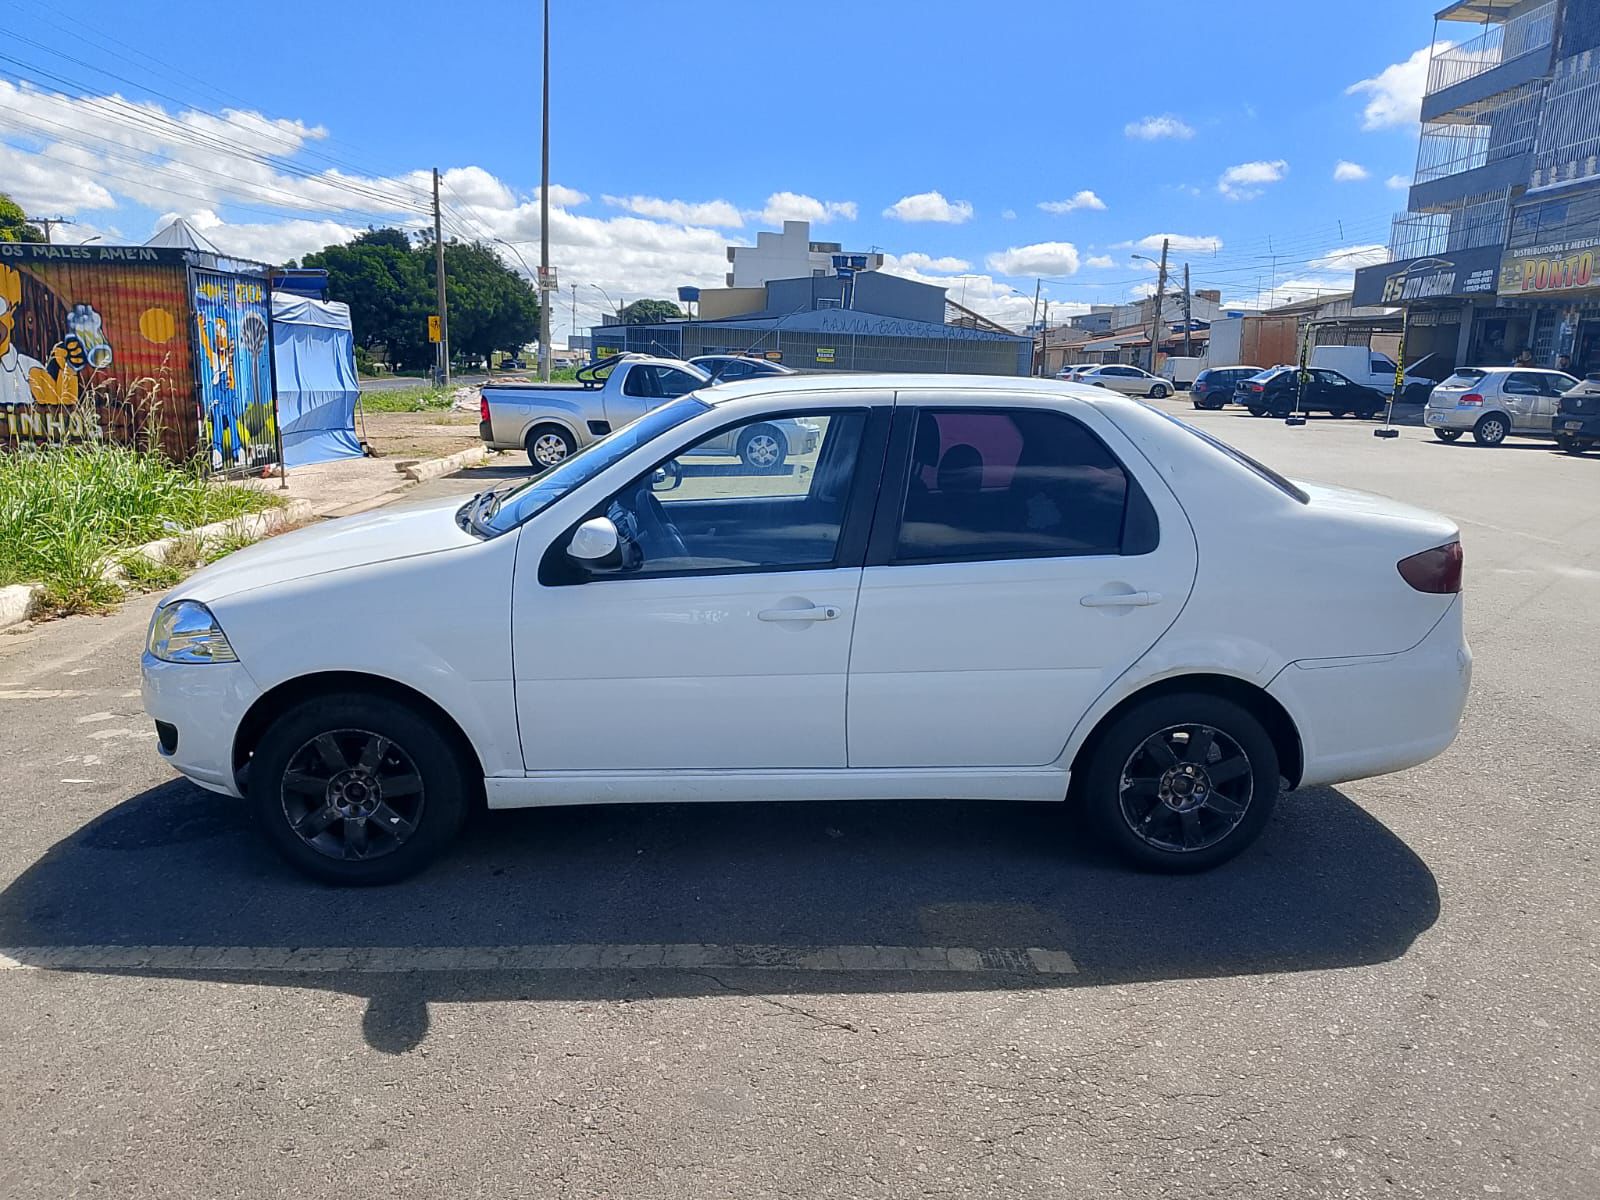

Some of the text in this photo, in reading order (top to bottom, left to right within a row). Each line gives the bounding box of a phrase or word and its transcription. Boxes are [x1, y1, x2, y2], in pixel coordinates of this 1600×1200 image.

[1, 245, 24, 257] OS
[32, 246, 91, 259] MALES
[1513, 244, 1563, 258] DISTRIBUIDORA
[1570, 238, 1600, 249] MERCEA
[1521, 251, 1594, 291] PONTO
[1381, 272, 1405, 303] RS
